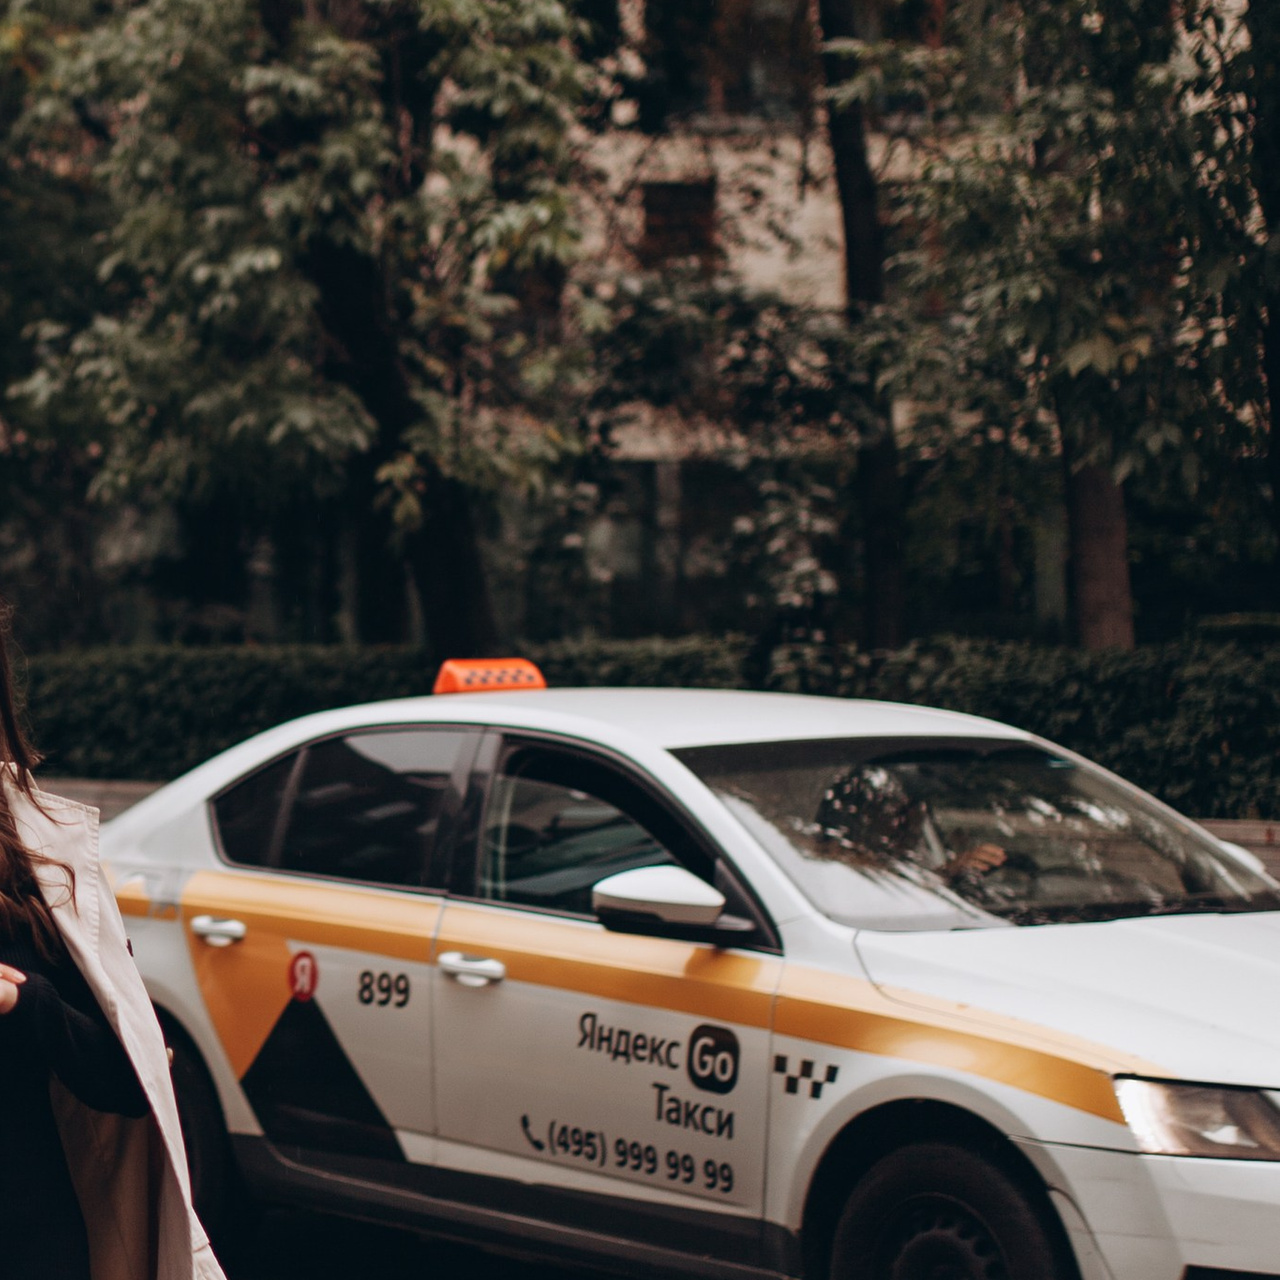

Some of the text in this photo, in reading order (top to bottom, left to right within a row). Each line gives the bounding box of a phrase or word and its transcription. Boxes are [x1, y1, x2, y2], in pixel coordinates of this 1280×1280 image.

[294, 956, 312, 994] Я
[358, 971, 410, 1008] 899
[578, 1011, 735, 1082] Яндекс Go
[652, 1082, 735, 1141] Такси
[549, 1120, 734, 1193] (495) 999 99 99
